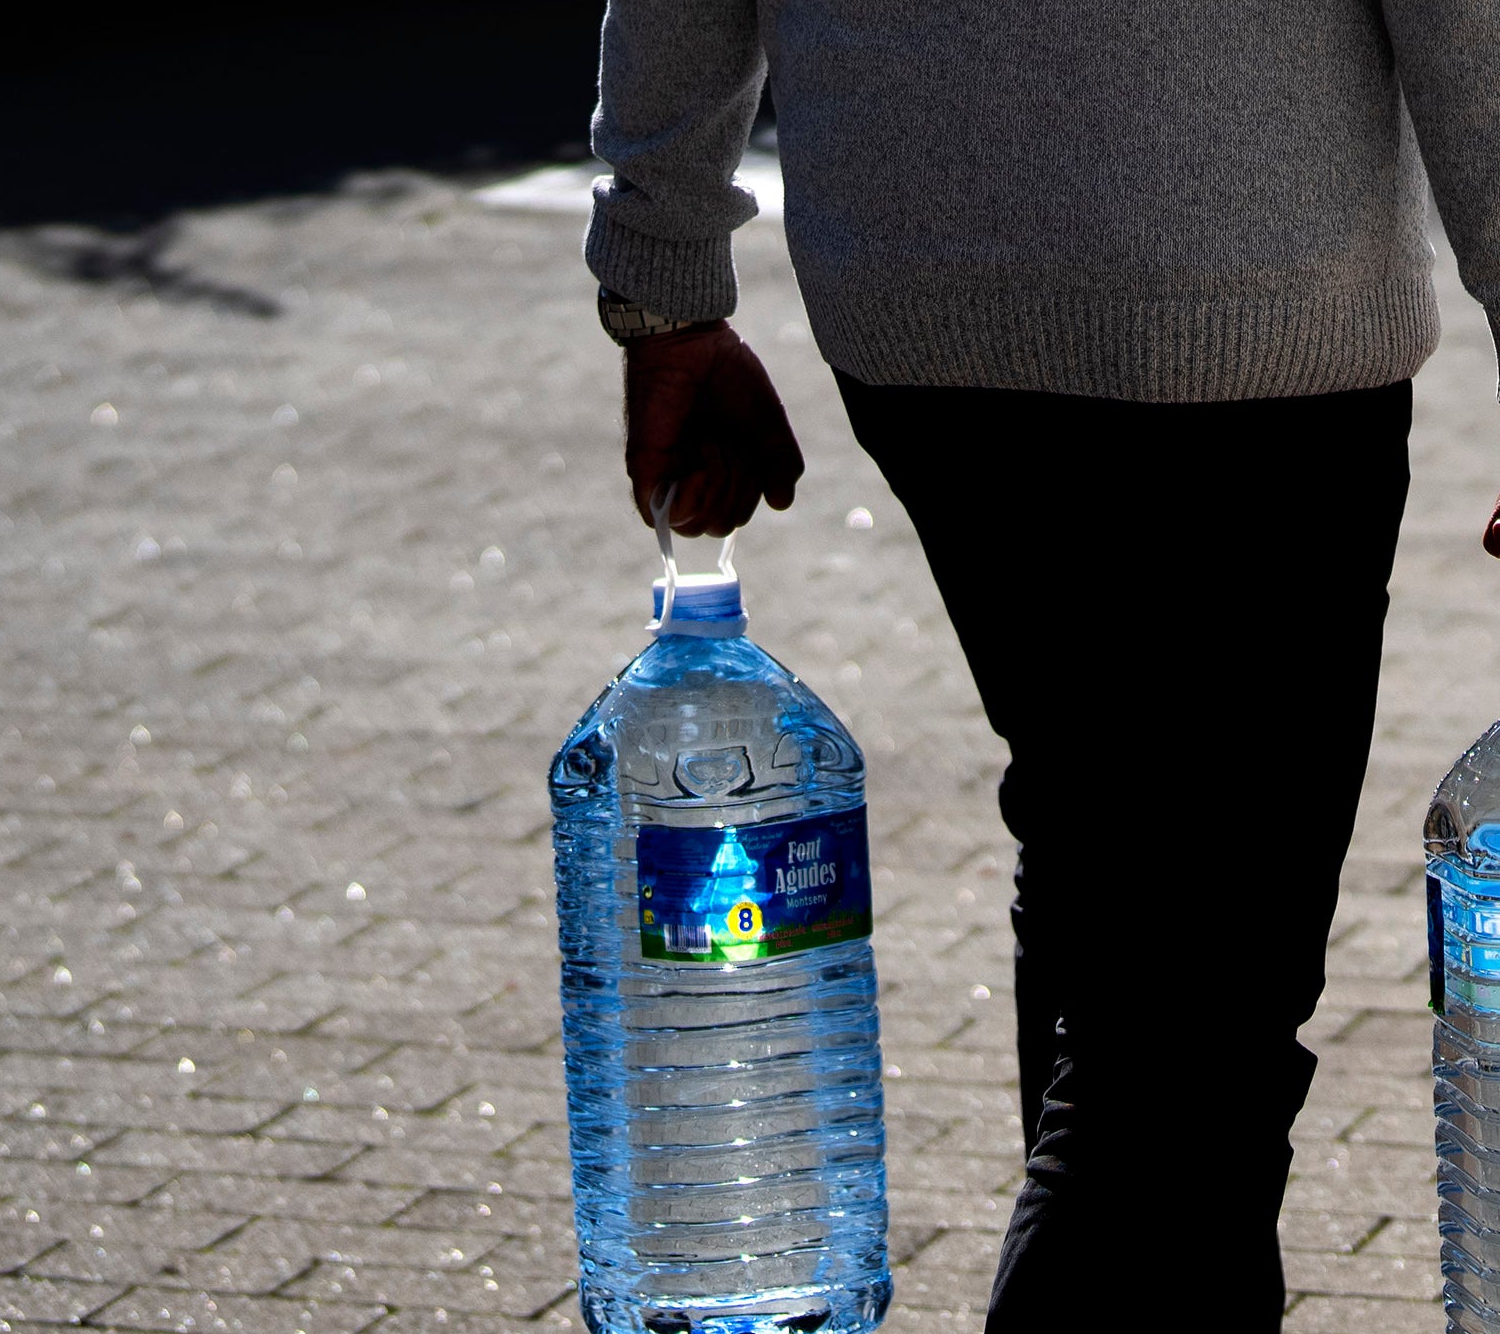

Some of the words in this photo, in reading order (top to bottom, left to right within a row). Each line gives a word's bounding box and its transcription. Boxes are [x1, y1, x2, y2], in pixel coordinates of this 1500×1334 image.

[788, 838, 821, 864] Font
[775, 862, 837, 895] Agudes
[786, 894, 828, 909] Montseny
[739, 908, 753, 932] 8
